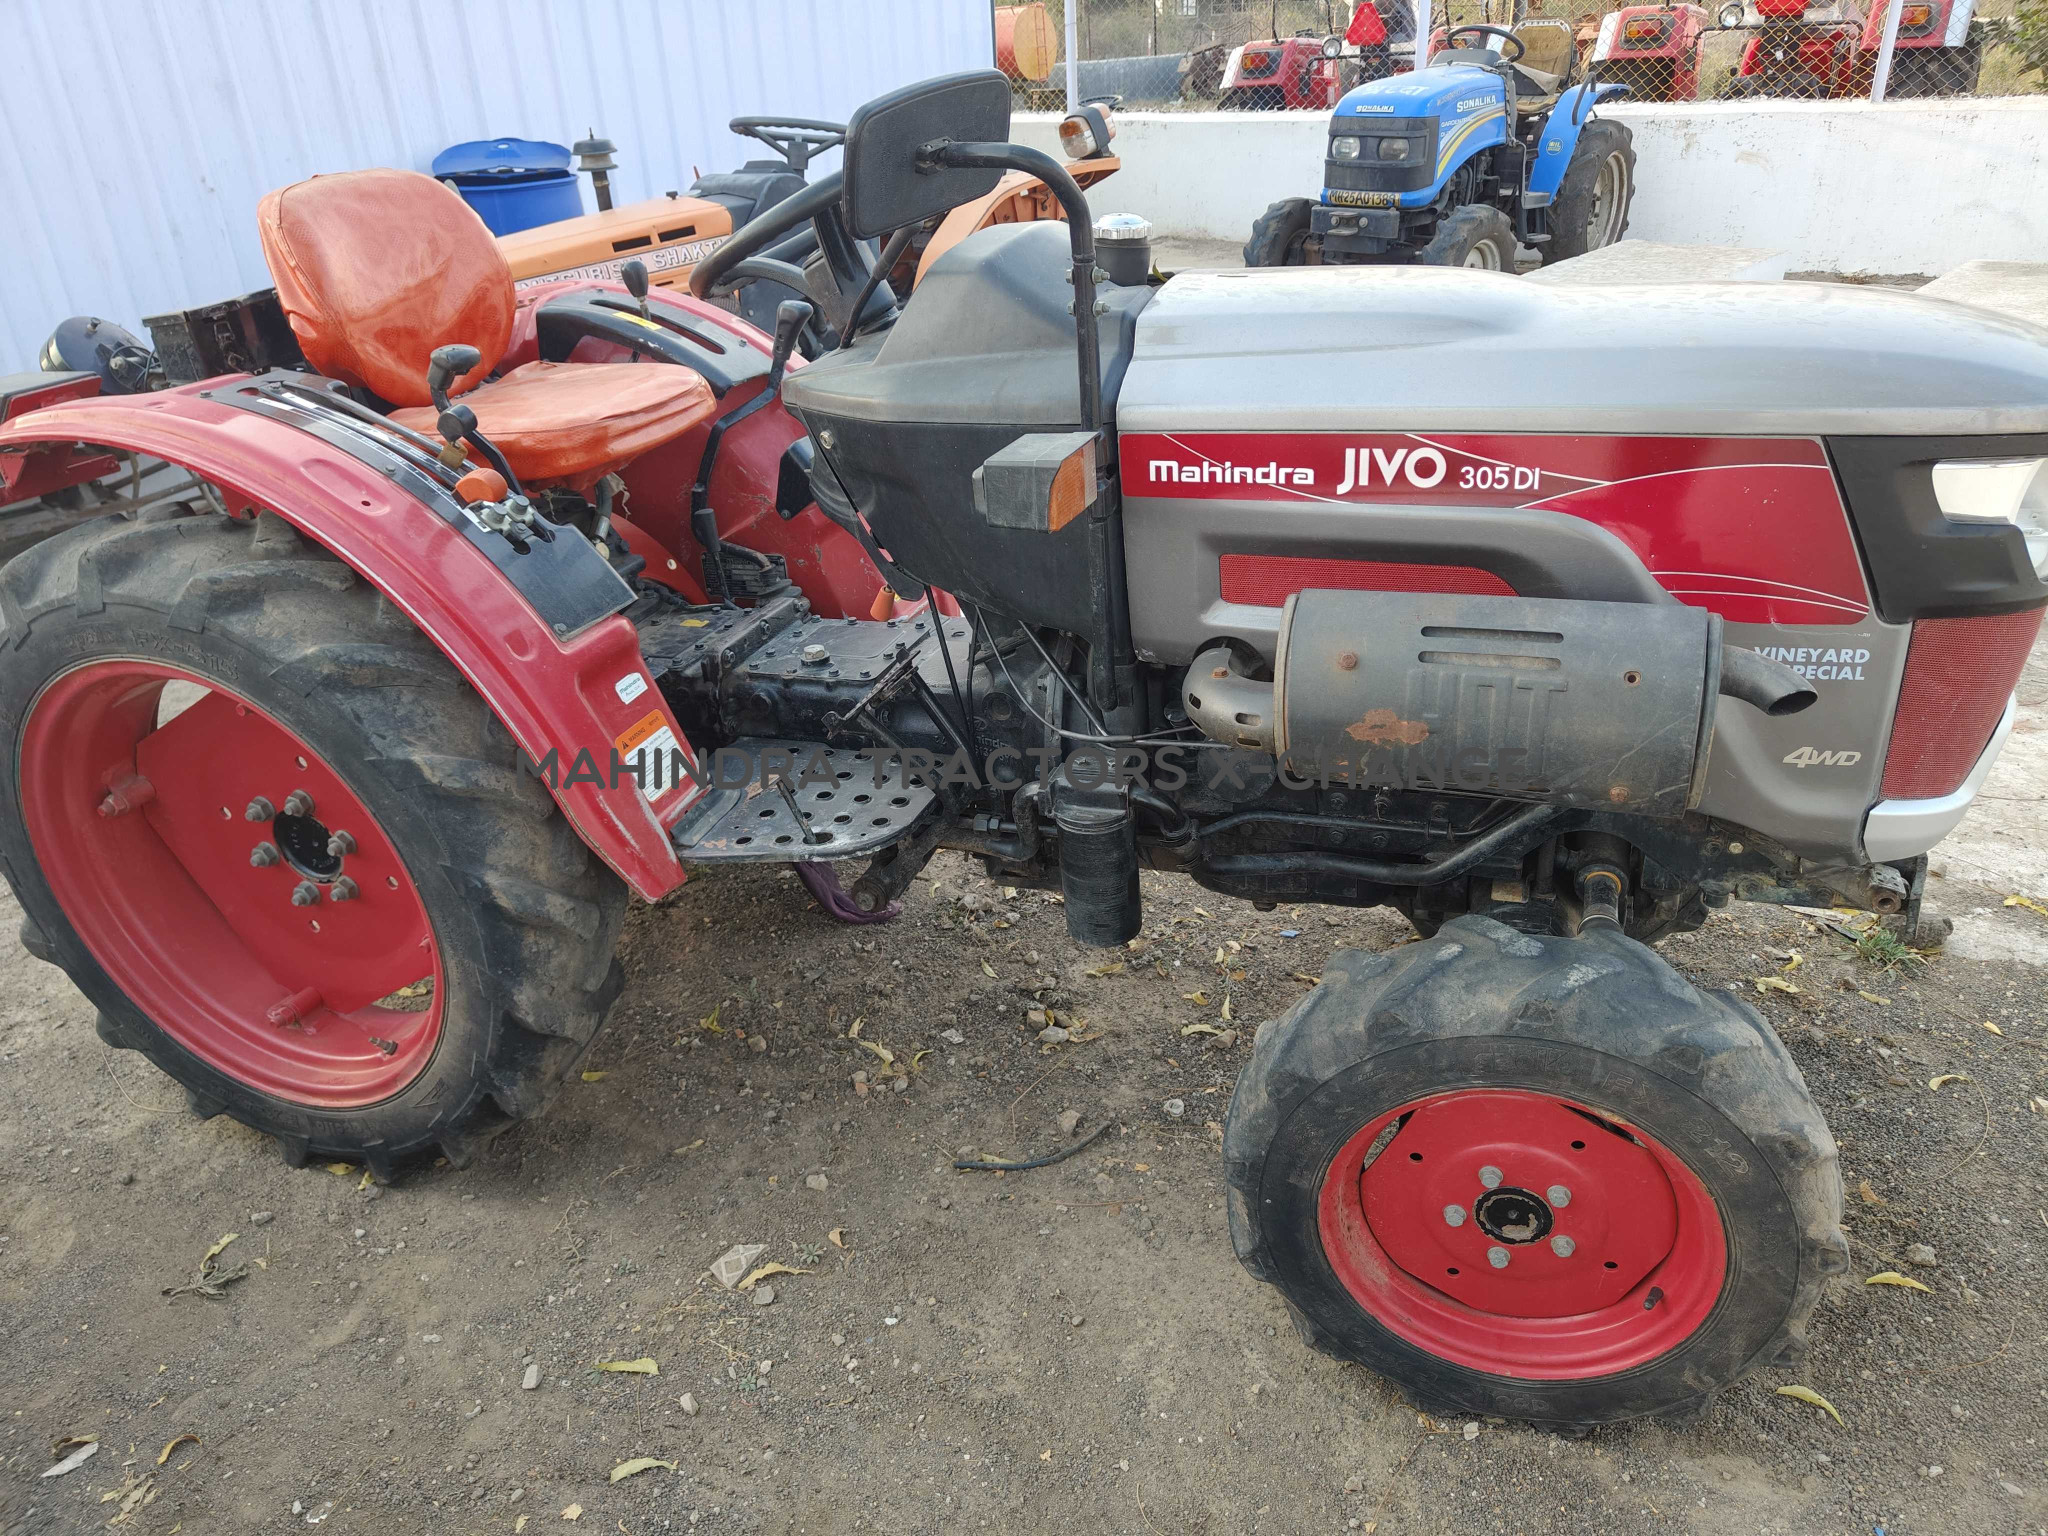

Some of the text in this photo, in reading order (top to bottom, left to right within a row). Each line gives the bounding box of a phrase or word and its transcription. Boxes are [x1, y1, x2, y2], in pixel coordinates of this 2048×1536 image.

[1356, 105, 1395, 113] SONALIKA
[1456, 94, 1496, 113] SONALIKA
[1148, 460, 1315, 485] Mahindra
[1336, 447, 1447, 495] JIVO
[1754, 646, 1871, 664] VINEYARD
[1783, 663, 1865, 681] PECIAL
[1782, 746, 1862, 769] 4WD
